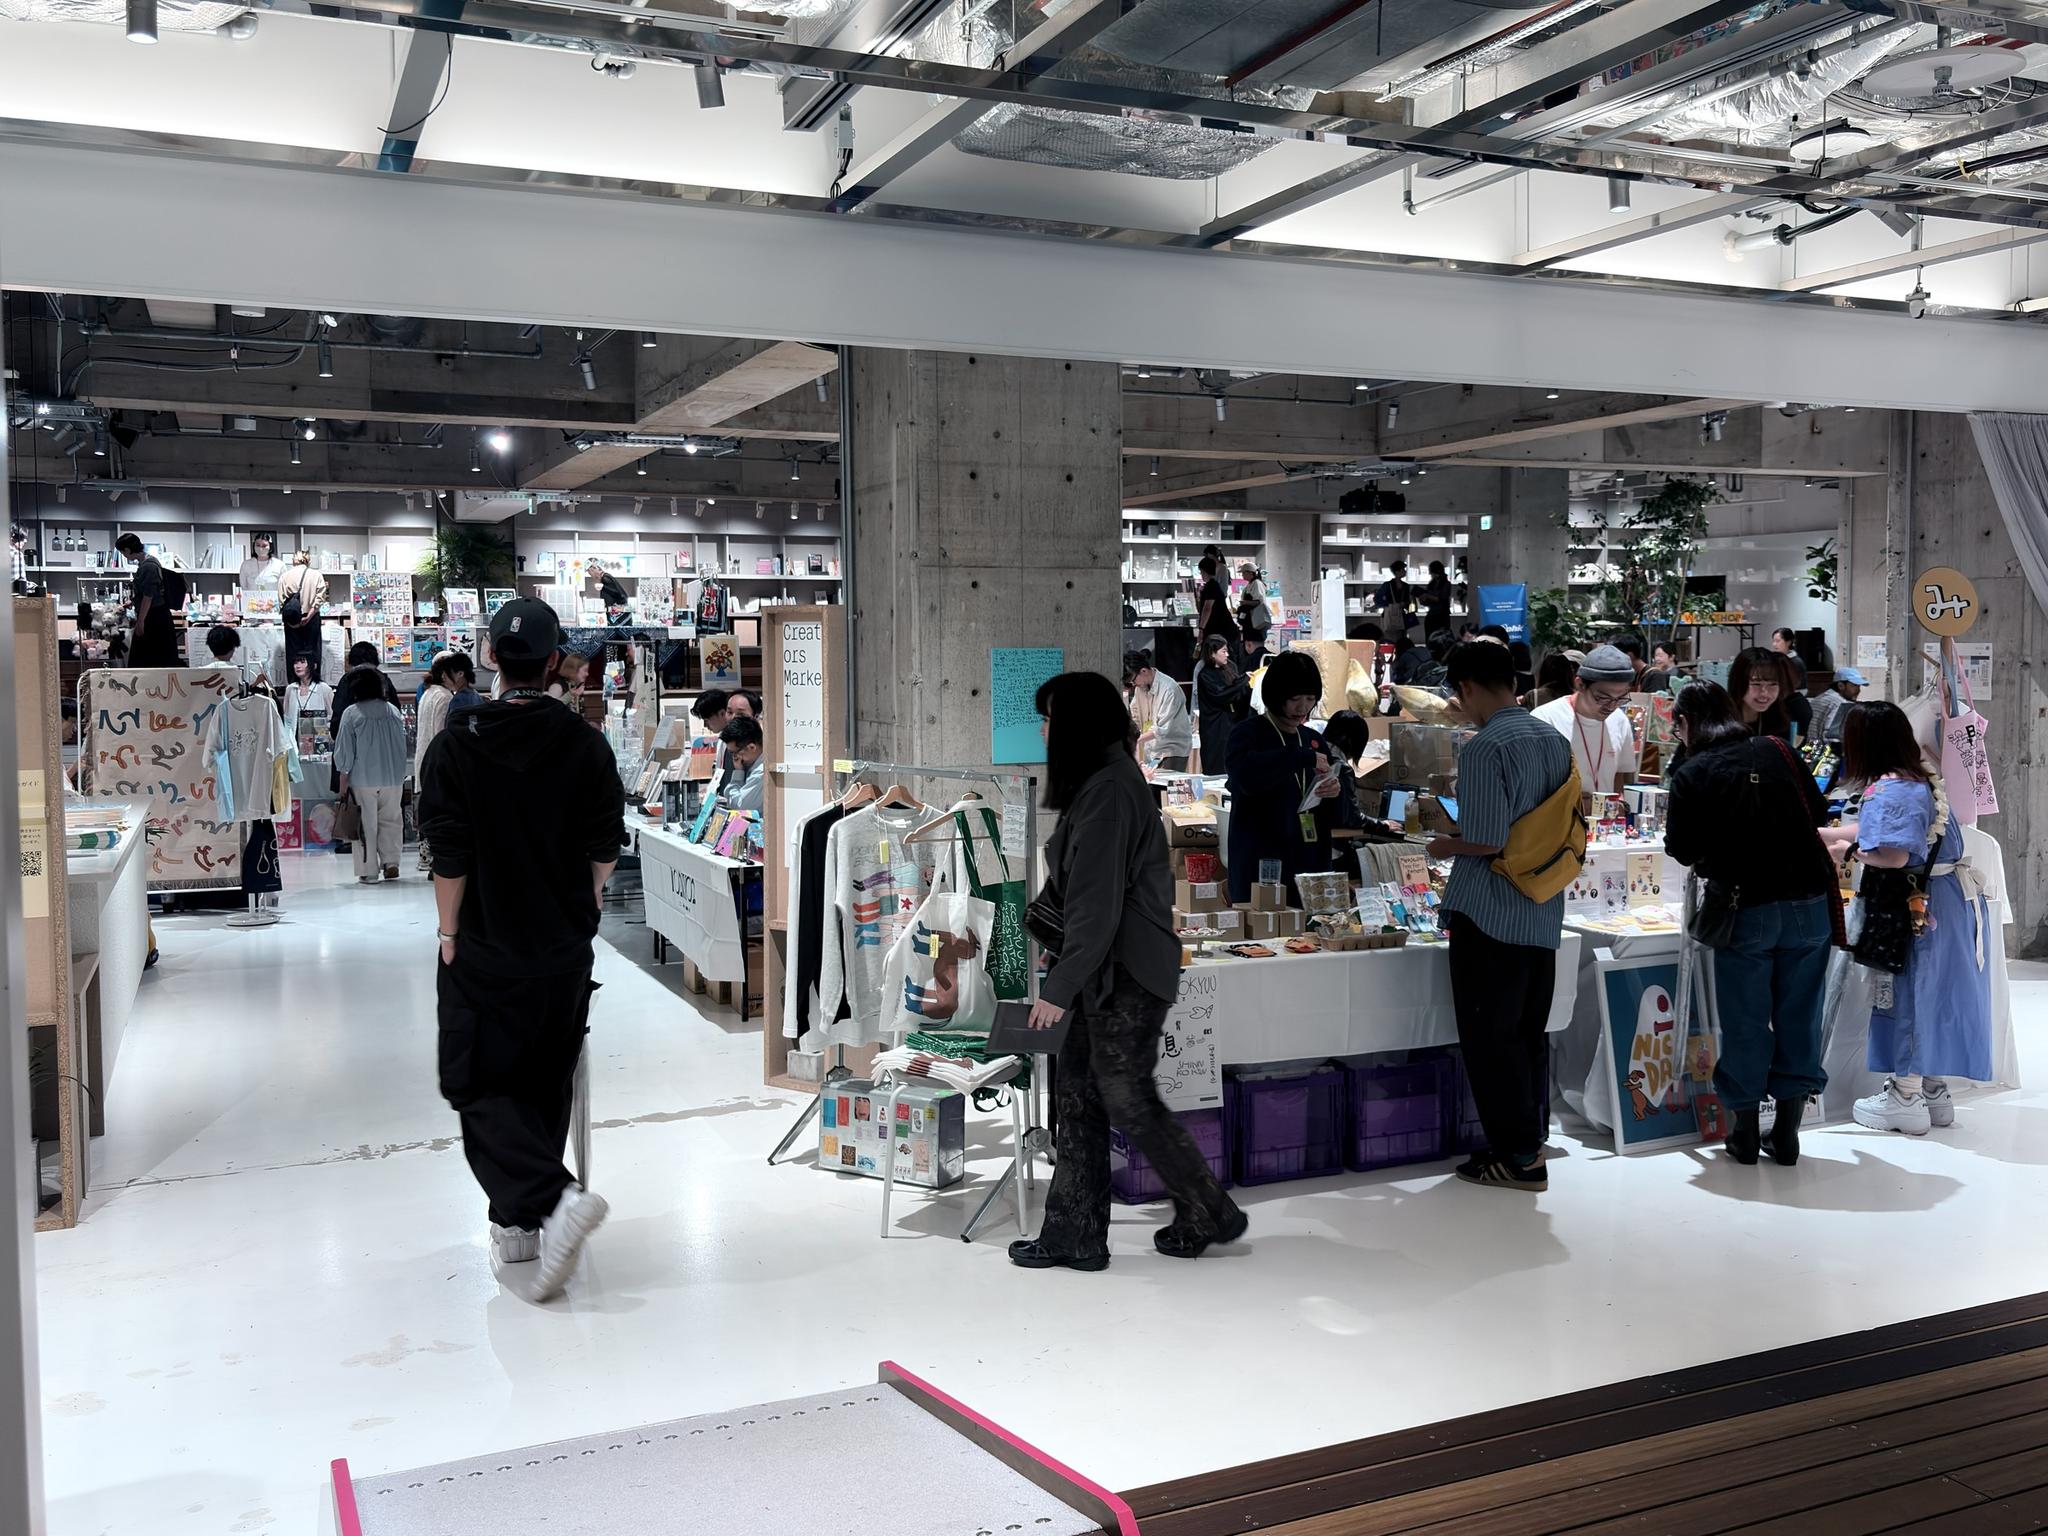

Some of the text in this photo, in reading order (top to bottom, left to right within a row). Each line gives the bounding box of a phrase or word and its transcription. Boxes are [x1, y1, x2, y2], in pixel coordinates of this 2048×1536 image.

[1924, 585, 1971, 620] み
[783, 624, 821, 641] Creat
[784, 648, 806, 663] ors
[784, 669, 822, 686] Marke
[785, 692, 791, 708] t
[785, 719, 821, 727] クリエイタ
[1178, 975, 1217, 996] OKYUU
